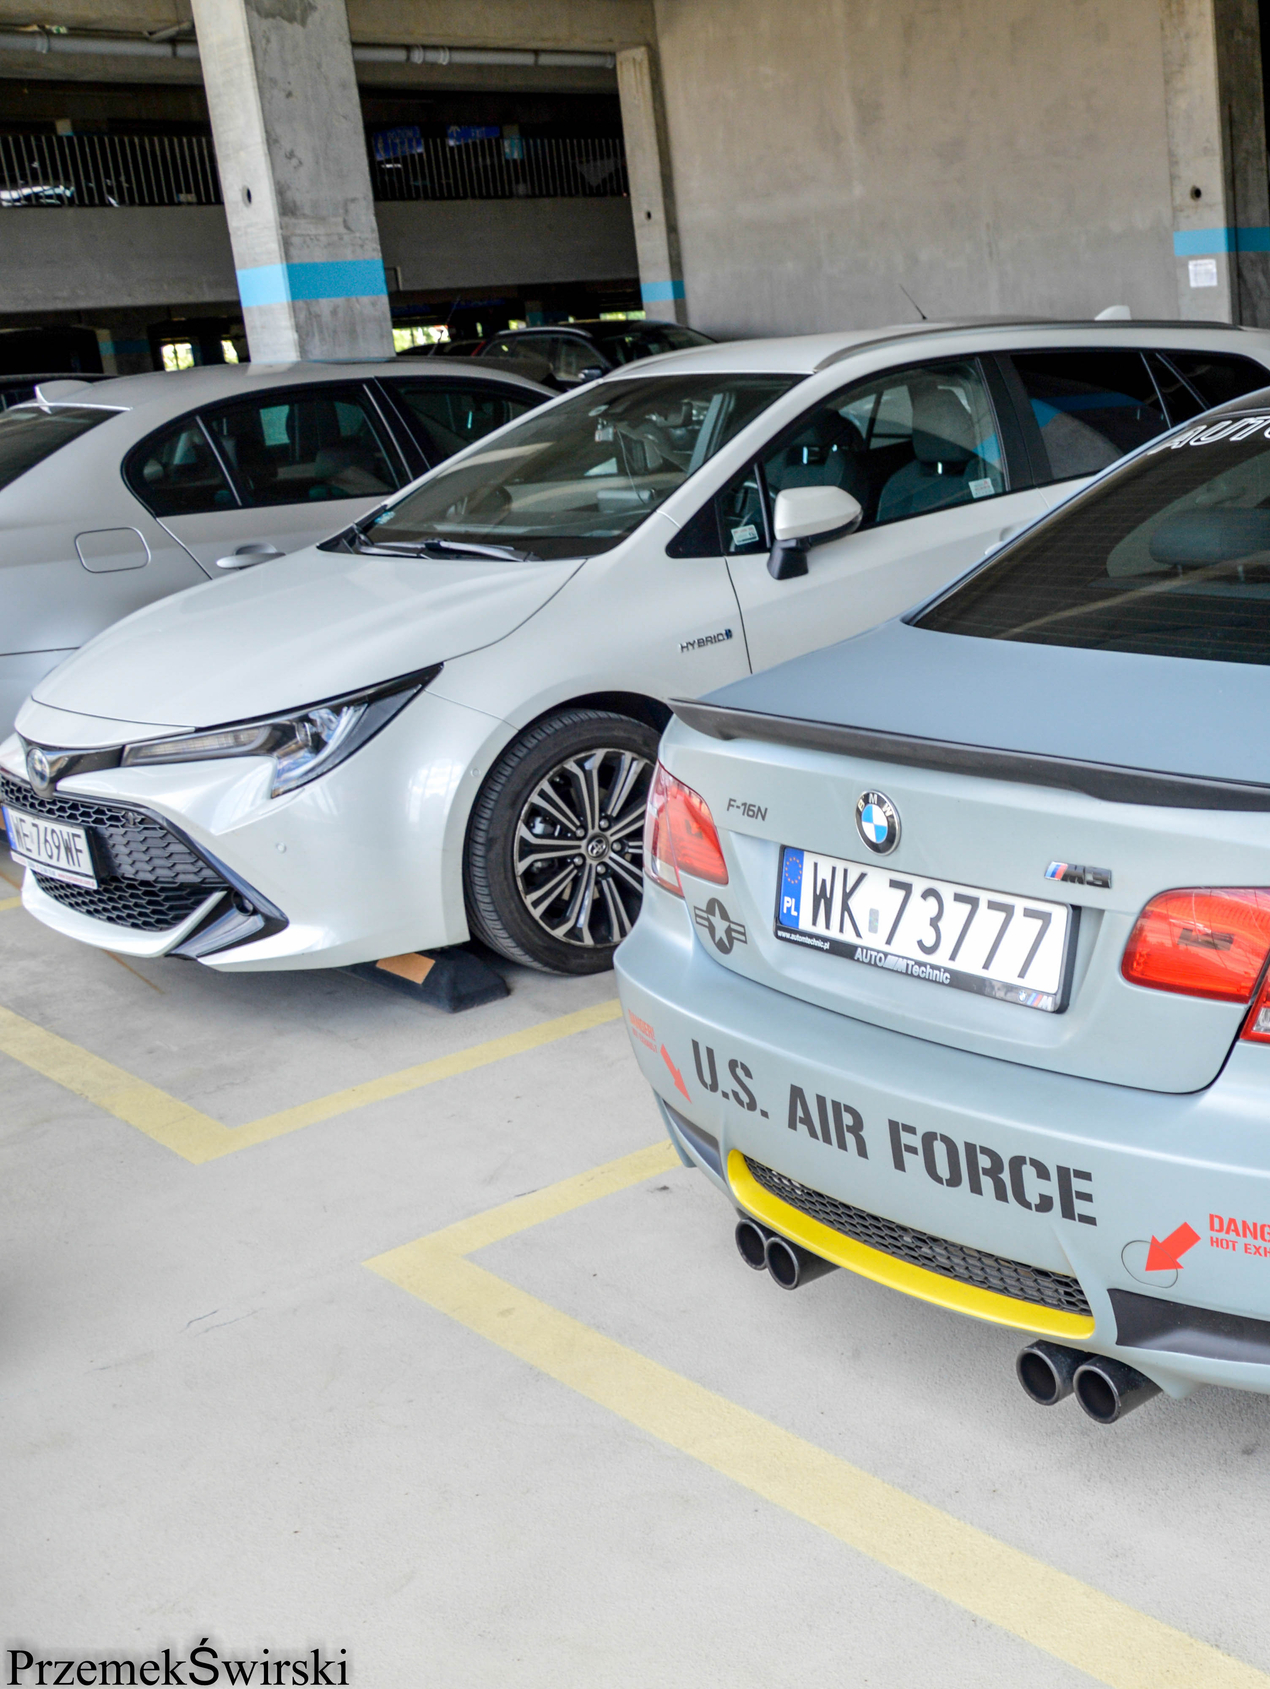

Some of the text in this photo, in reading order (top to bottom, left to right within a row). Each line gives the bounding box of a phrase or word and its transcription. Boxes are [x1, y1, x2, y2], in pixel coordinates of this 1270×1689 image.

[679, 632, 726, 653] HYBRID
[727, 798, 768, 822] F-16N
[783, 896, 798, 916] PL
[812, 861, 1052, 979] WK 73777
[692, 1038, 1098, 1227] U.S. AIR FORCE
[1210, 1236, 1238, 1252] HOT
